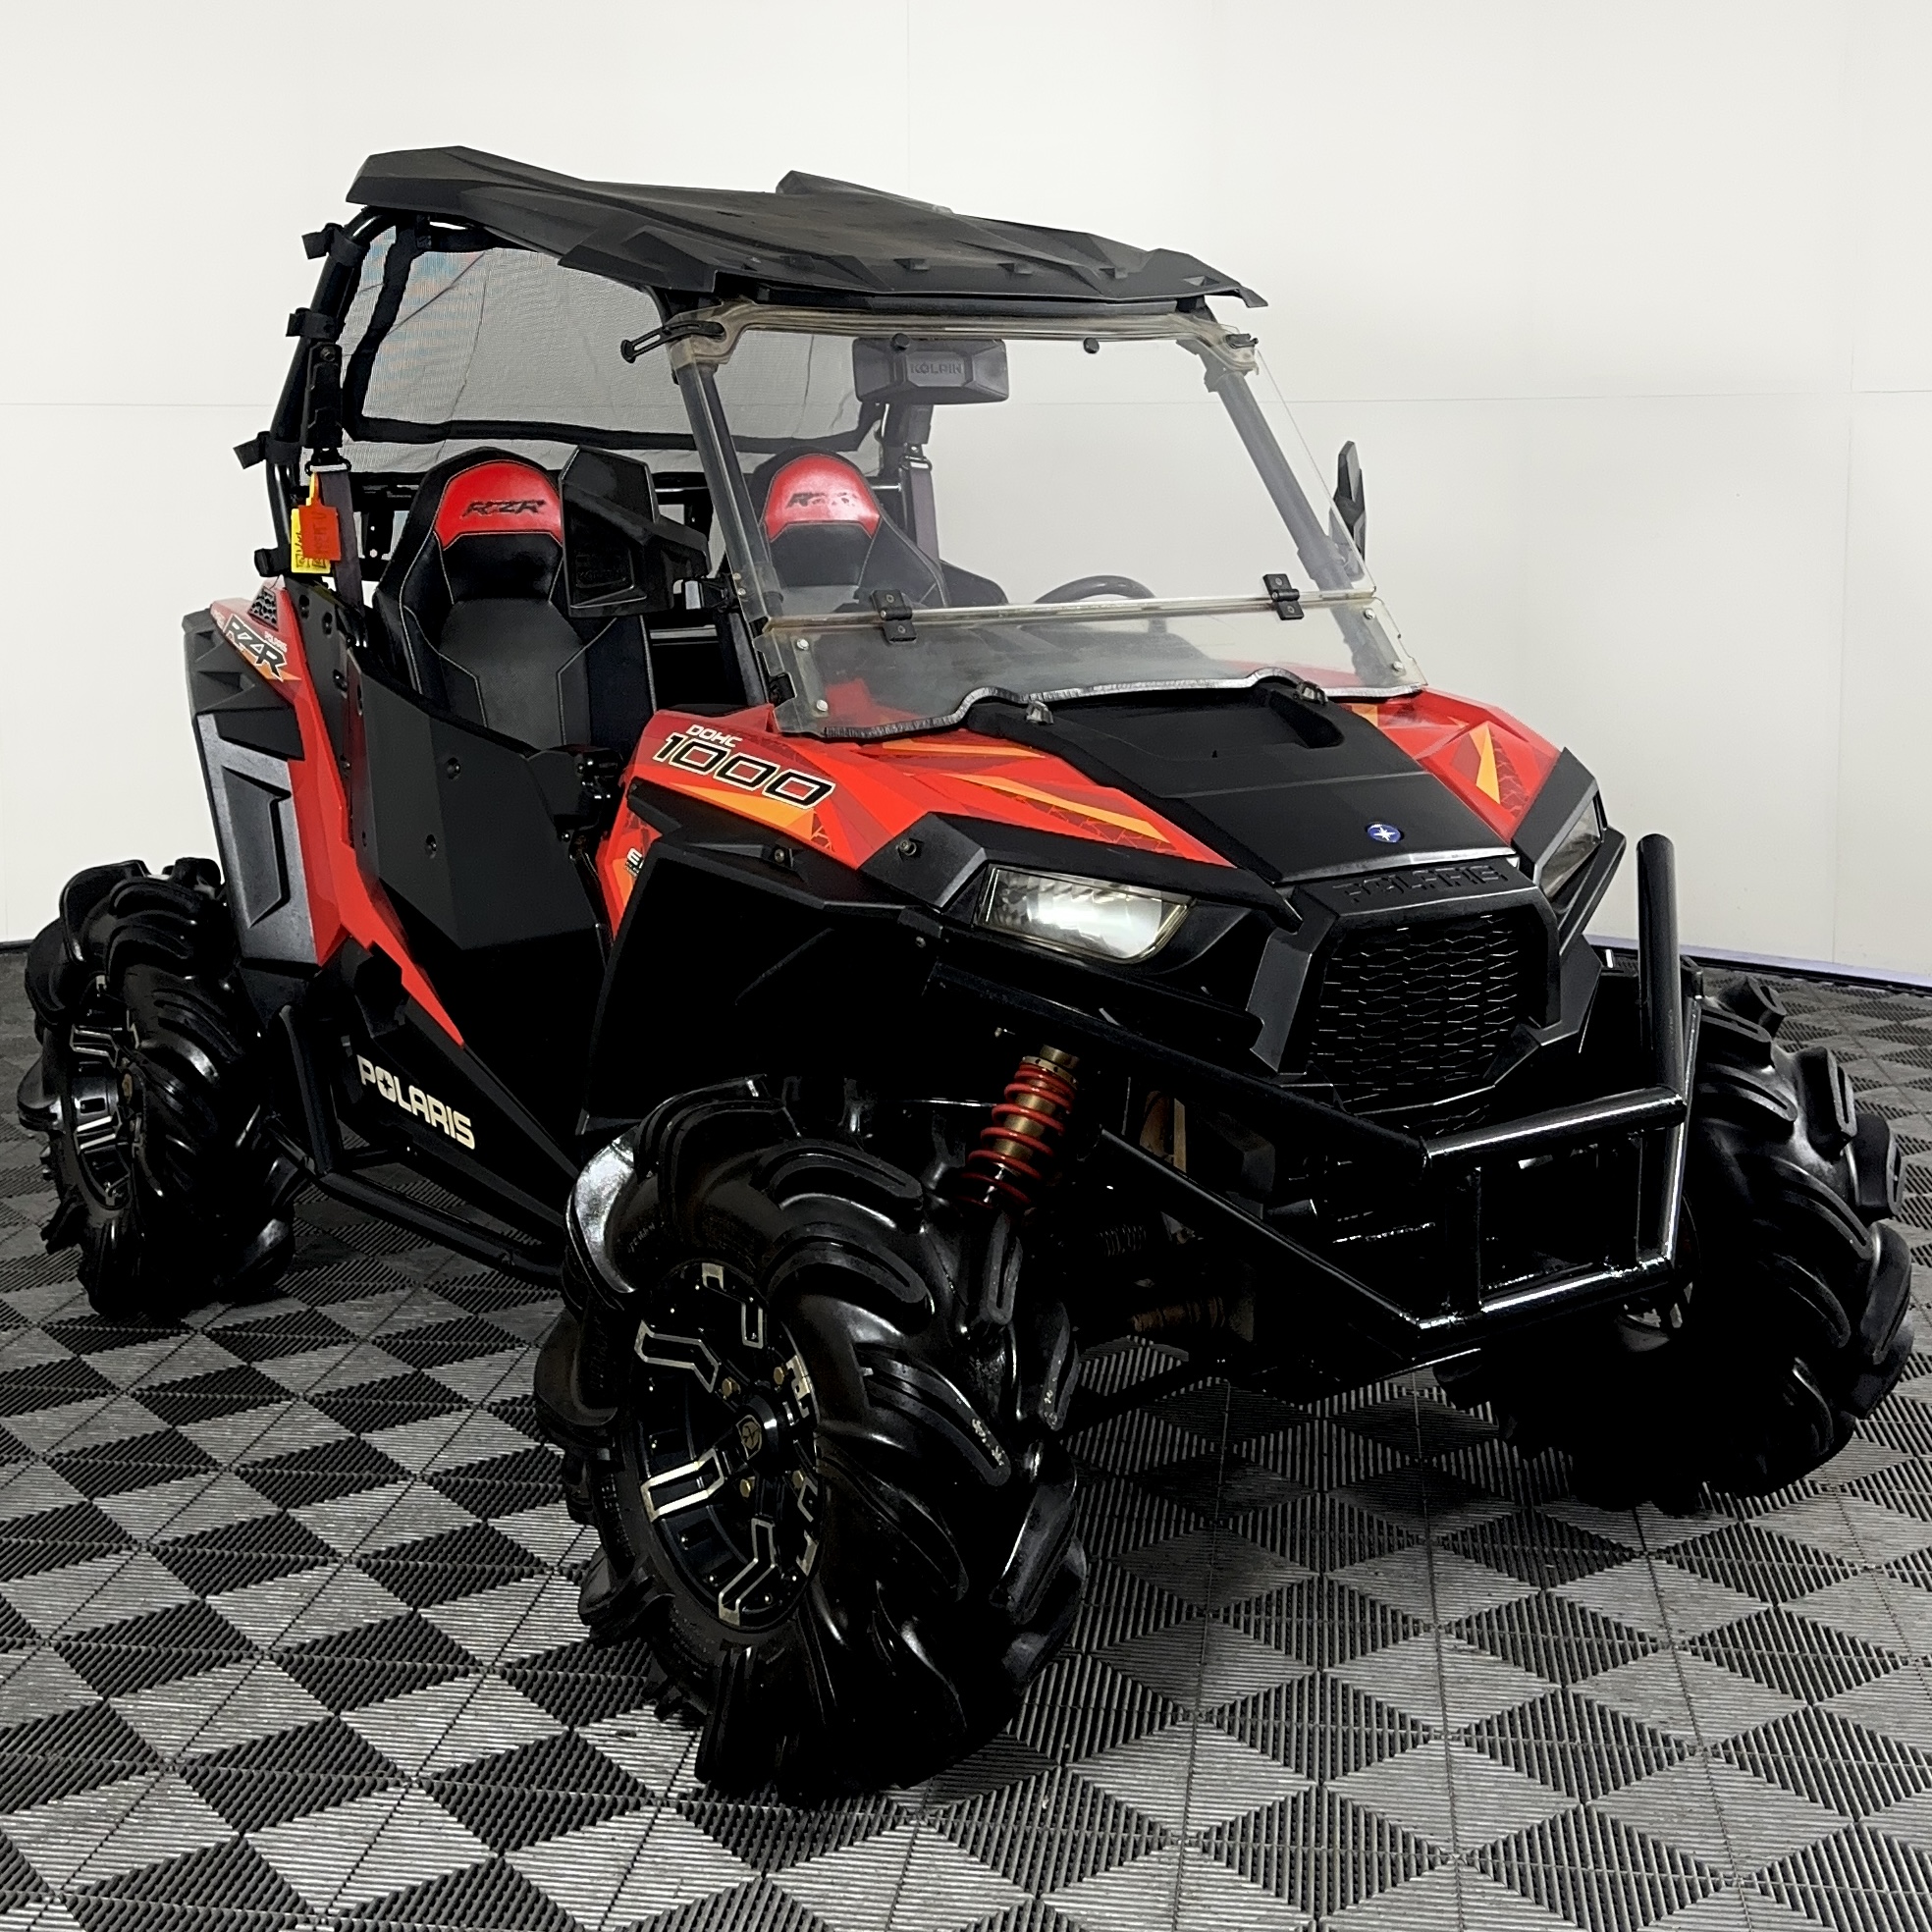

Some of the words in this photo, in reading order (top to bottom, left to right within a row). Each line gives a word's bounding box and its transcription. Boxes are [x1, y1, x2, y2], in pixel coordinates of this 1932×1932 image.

[909, 360, 963, 376] KOLPIN
[461, 500, 546, 516] RZR
[223, 614, 288, 682] RZR
[685, 724, 743, 748] DOHC
[652, 731, 836, 810] 1000
[1332, 865, 1509, 903] POLARIS
[356, 1054, 476, 1151] POLARIS
